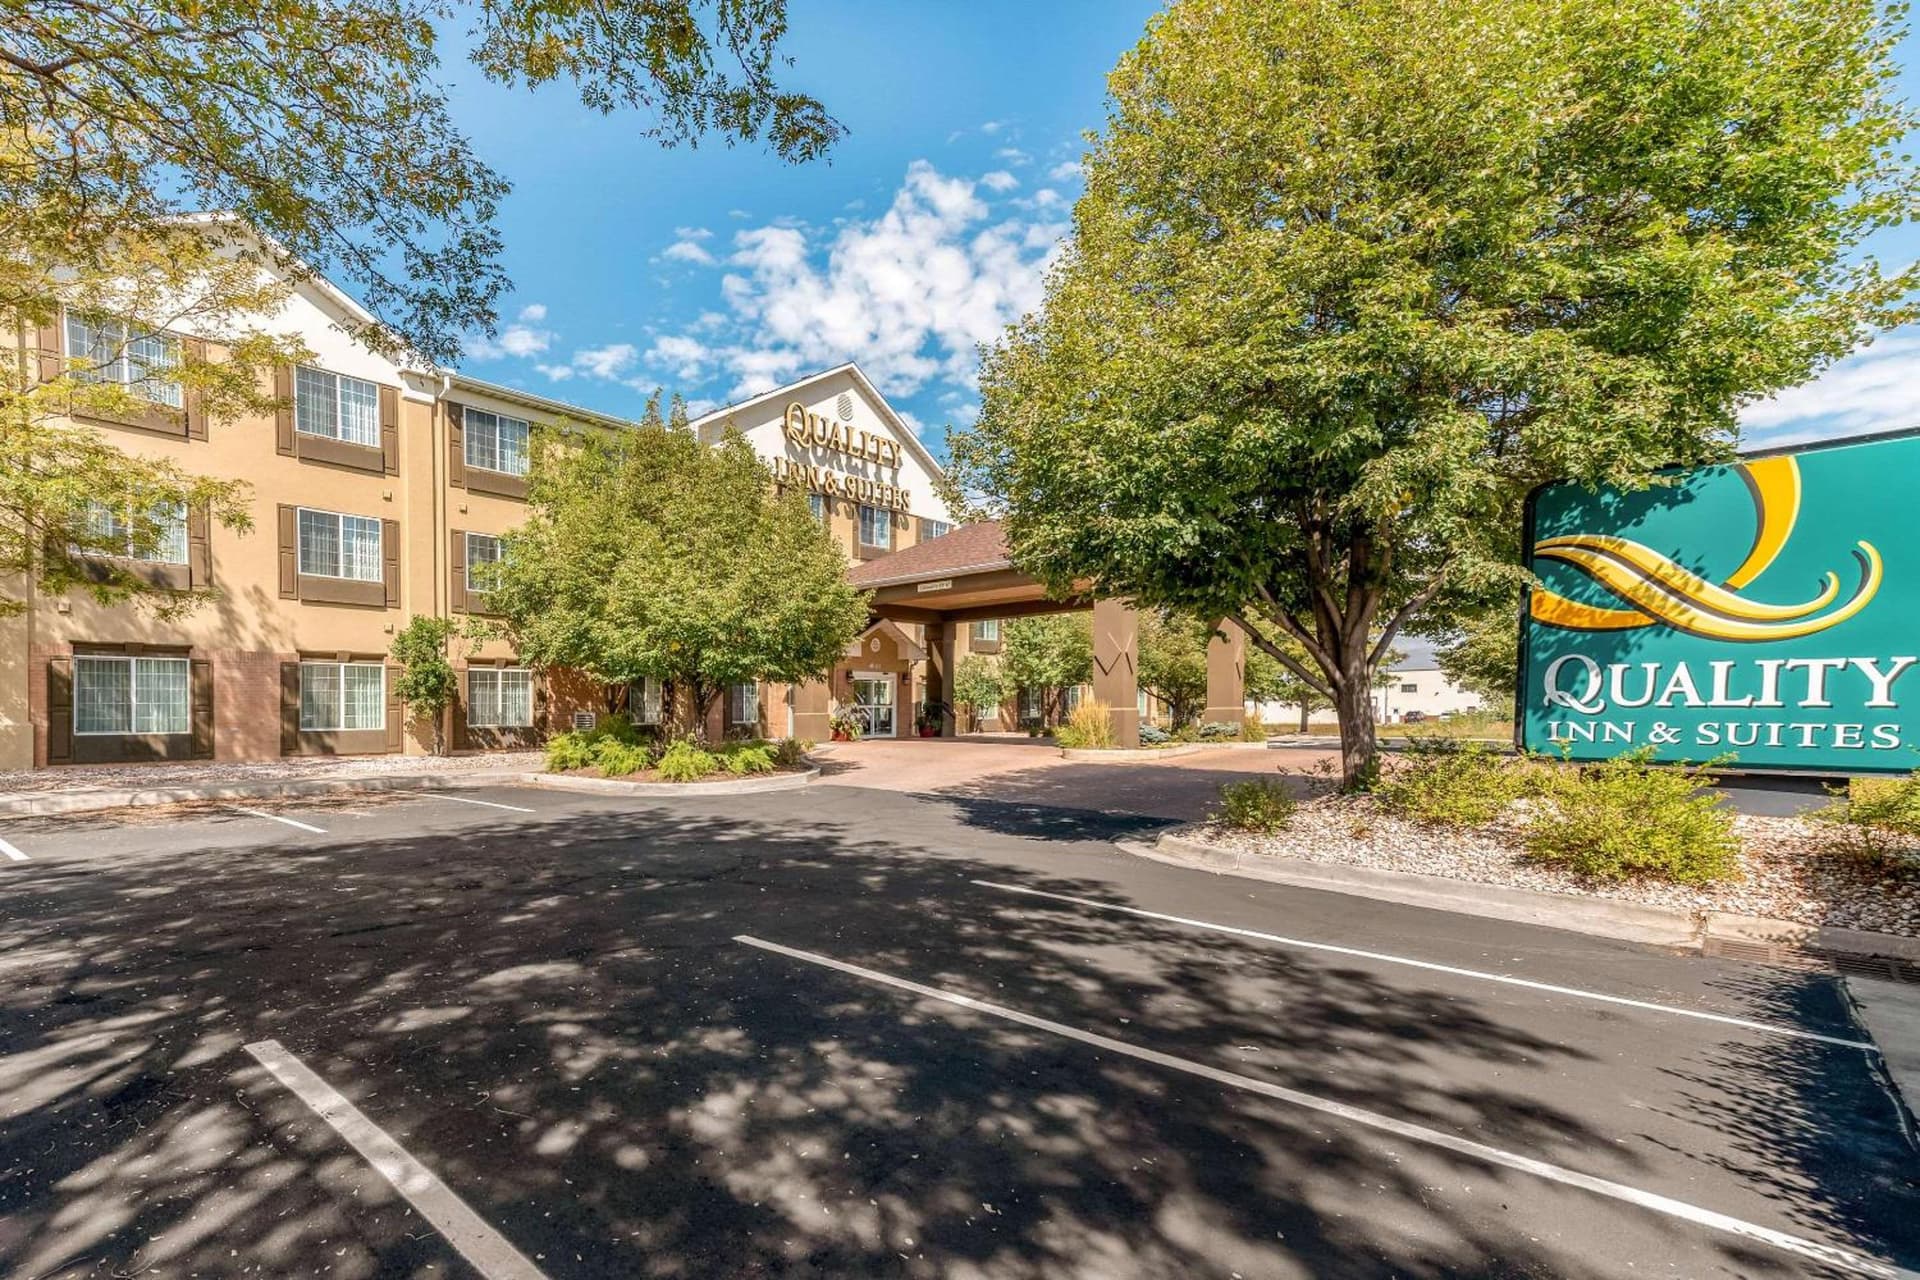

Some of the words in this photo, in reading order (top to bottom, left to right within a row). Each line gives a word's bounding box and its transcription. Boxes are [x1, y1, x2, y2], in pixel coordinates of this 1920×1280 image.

[785, 402, 903, 470] QUALITY
[775, 457, 820, 492] INN
[824, 470, 840, 496] &
[845, 475, 911, 511] SUITES
[1543, 654, 1917, 714] QUALITY
[1547, 721, 1635, 743] INN
[1648, 721, 1681, 744] &
[1696, 722, 1901, 749] SUITES
